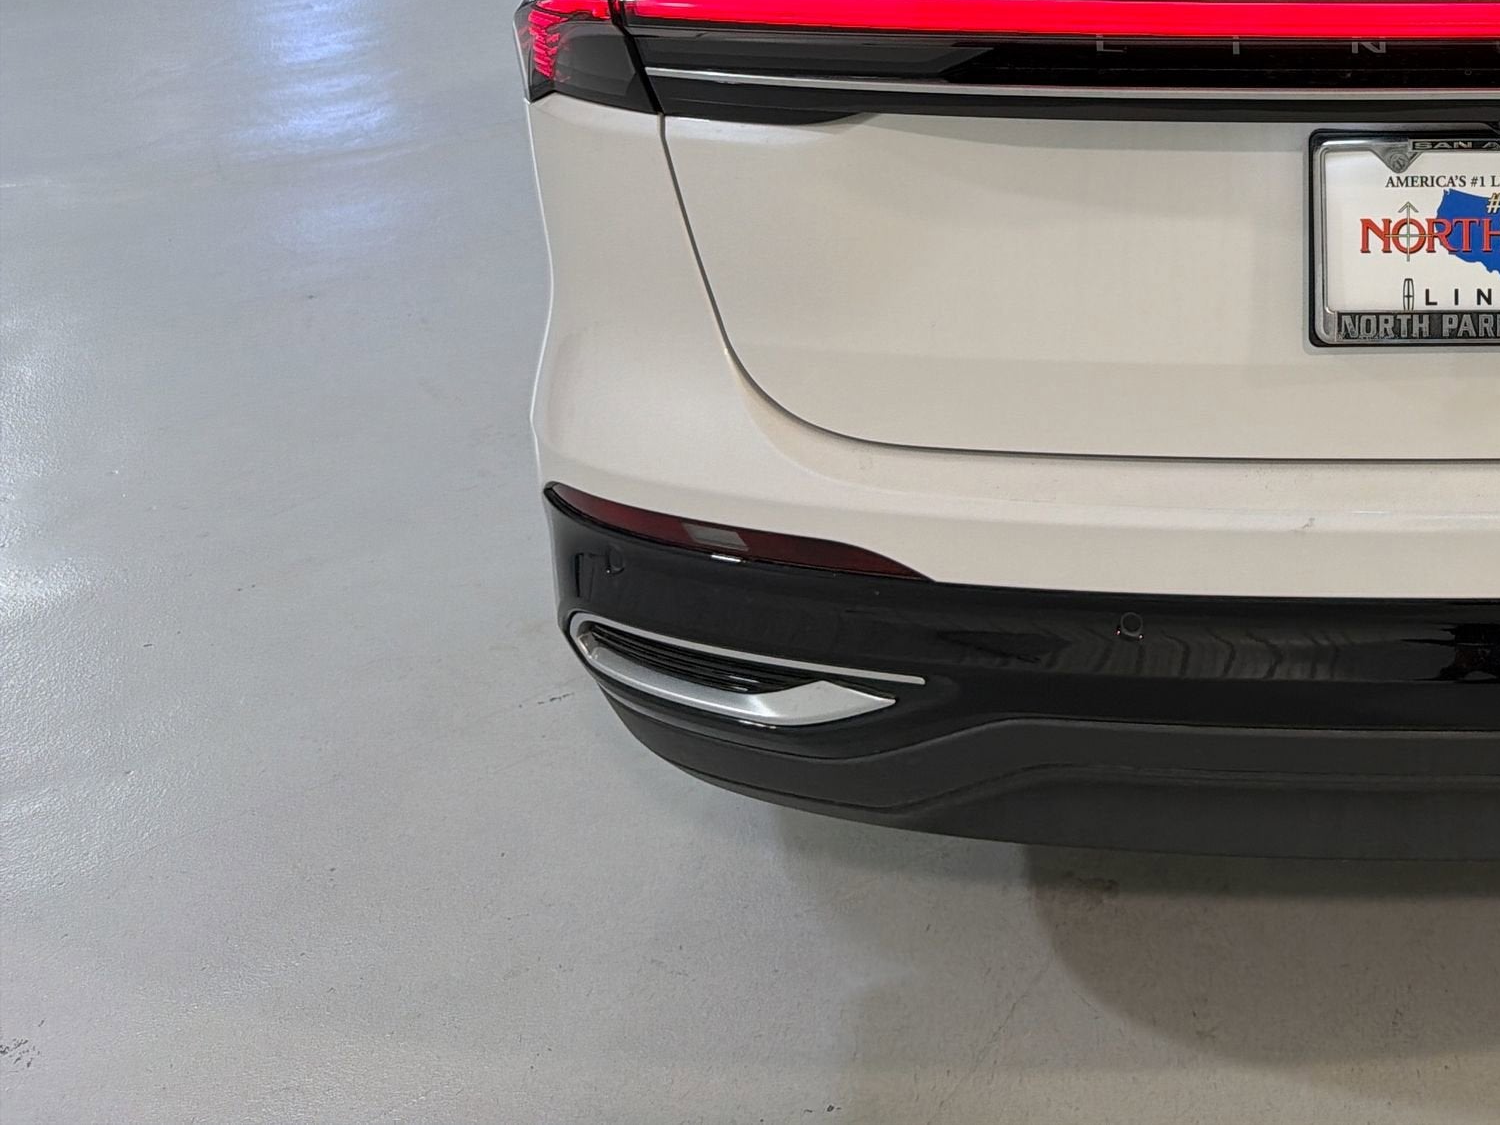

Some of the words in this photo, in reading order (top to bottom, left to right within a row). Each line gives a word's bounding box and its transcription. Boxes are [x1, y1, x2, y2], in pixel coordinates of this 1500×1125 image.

[1414, 141, 1472, 150] SAN
[1385, 175, 1467, 188] AMERICA'S
[1470, 176, 1486, 187] #1
[1339, 313, 1430, 339] NORTH
